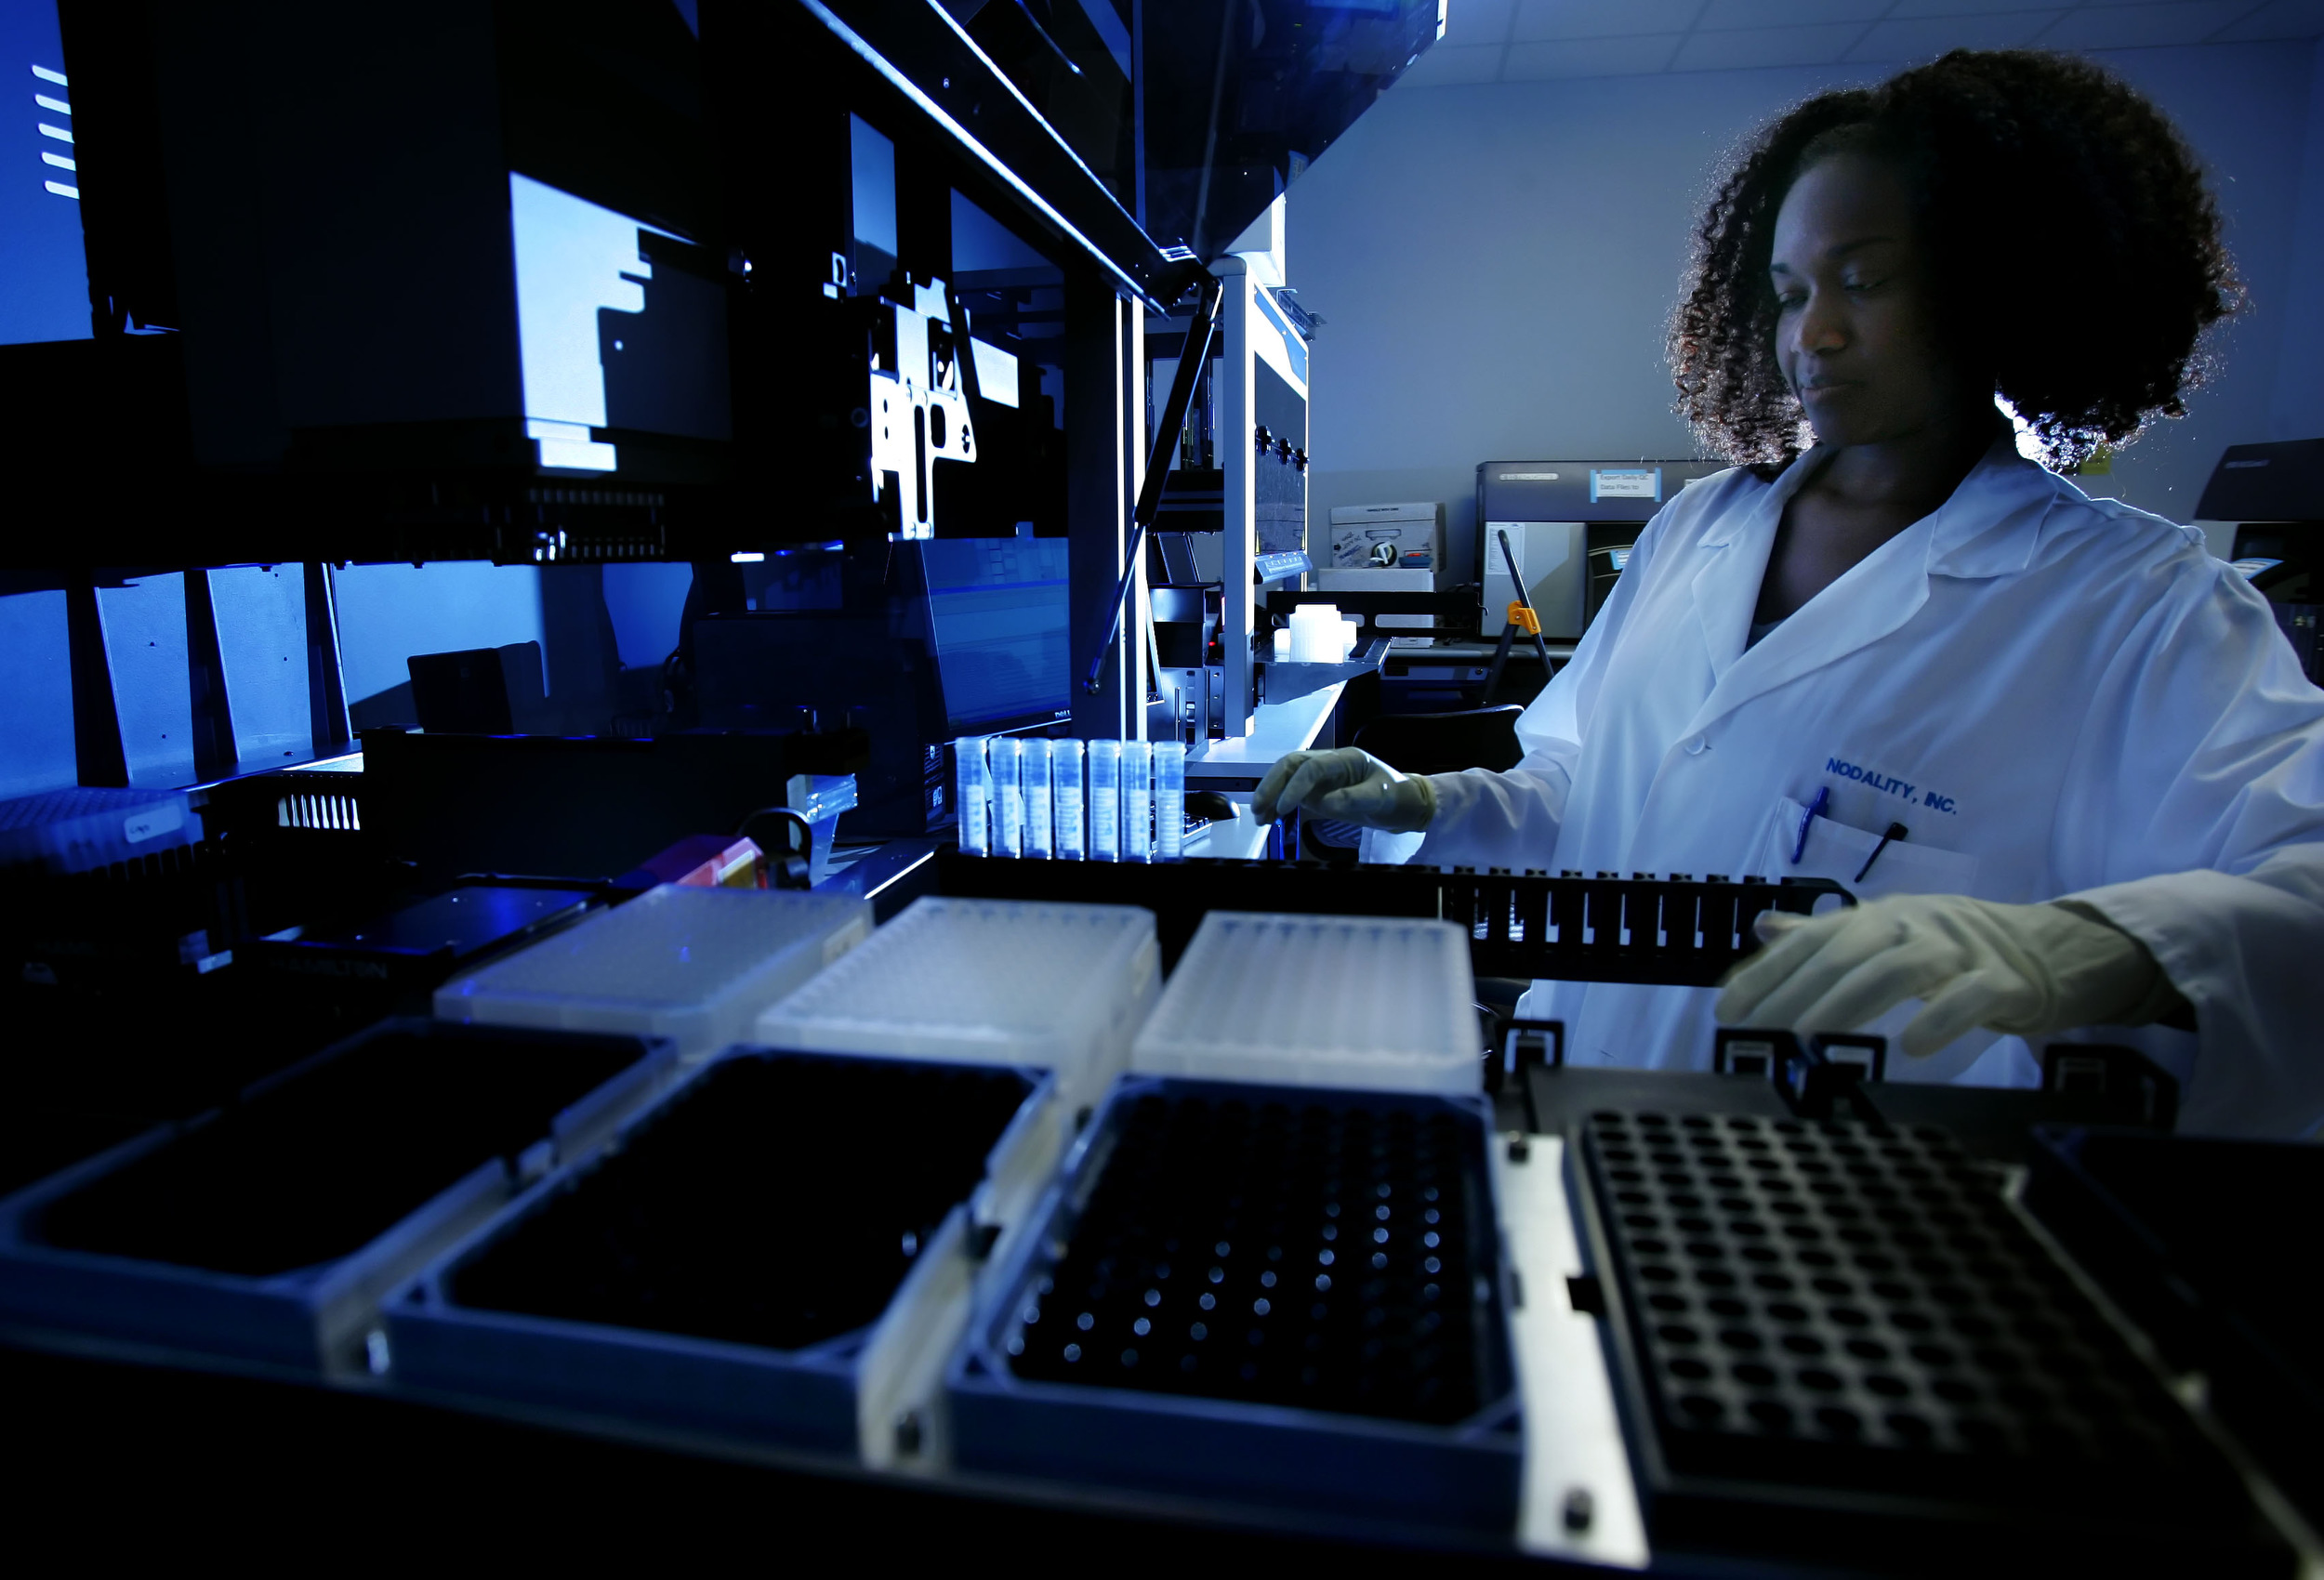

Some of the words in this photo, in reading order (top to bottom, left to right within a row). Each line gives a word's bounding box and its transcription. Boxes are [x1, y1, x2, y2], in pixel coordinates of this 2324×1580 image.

[1054, 709, 1071, 718] DELL
[1826, 757, 1917, 804] NODALITY,
[1923, 791, 1956, 815] INC.
